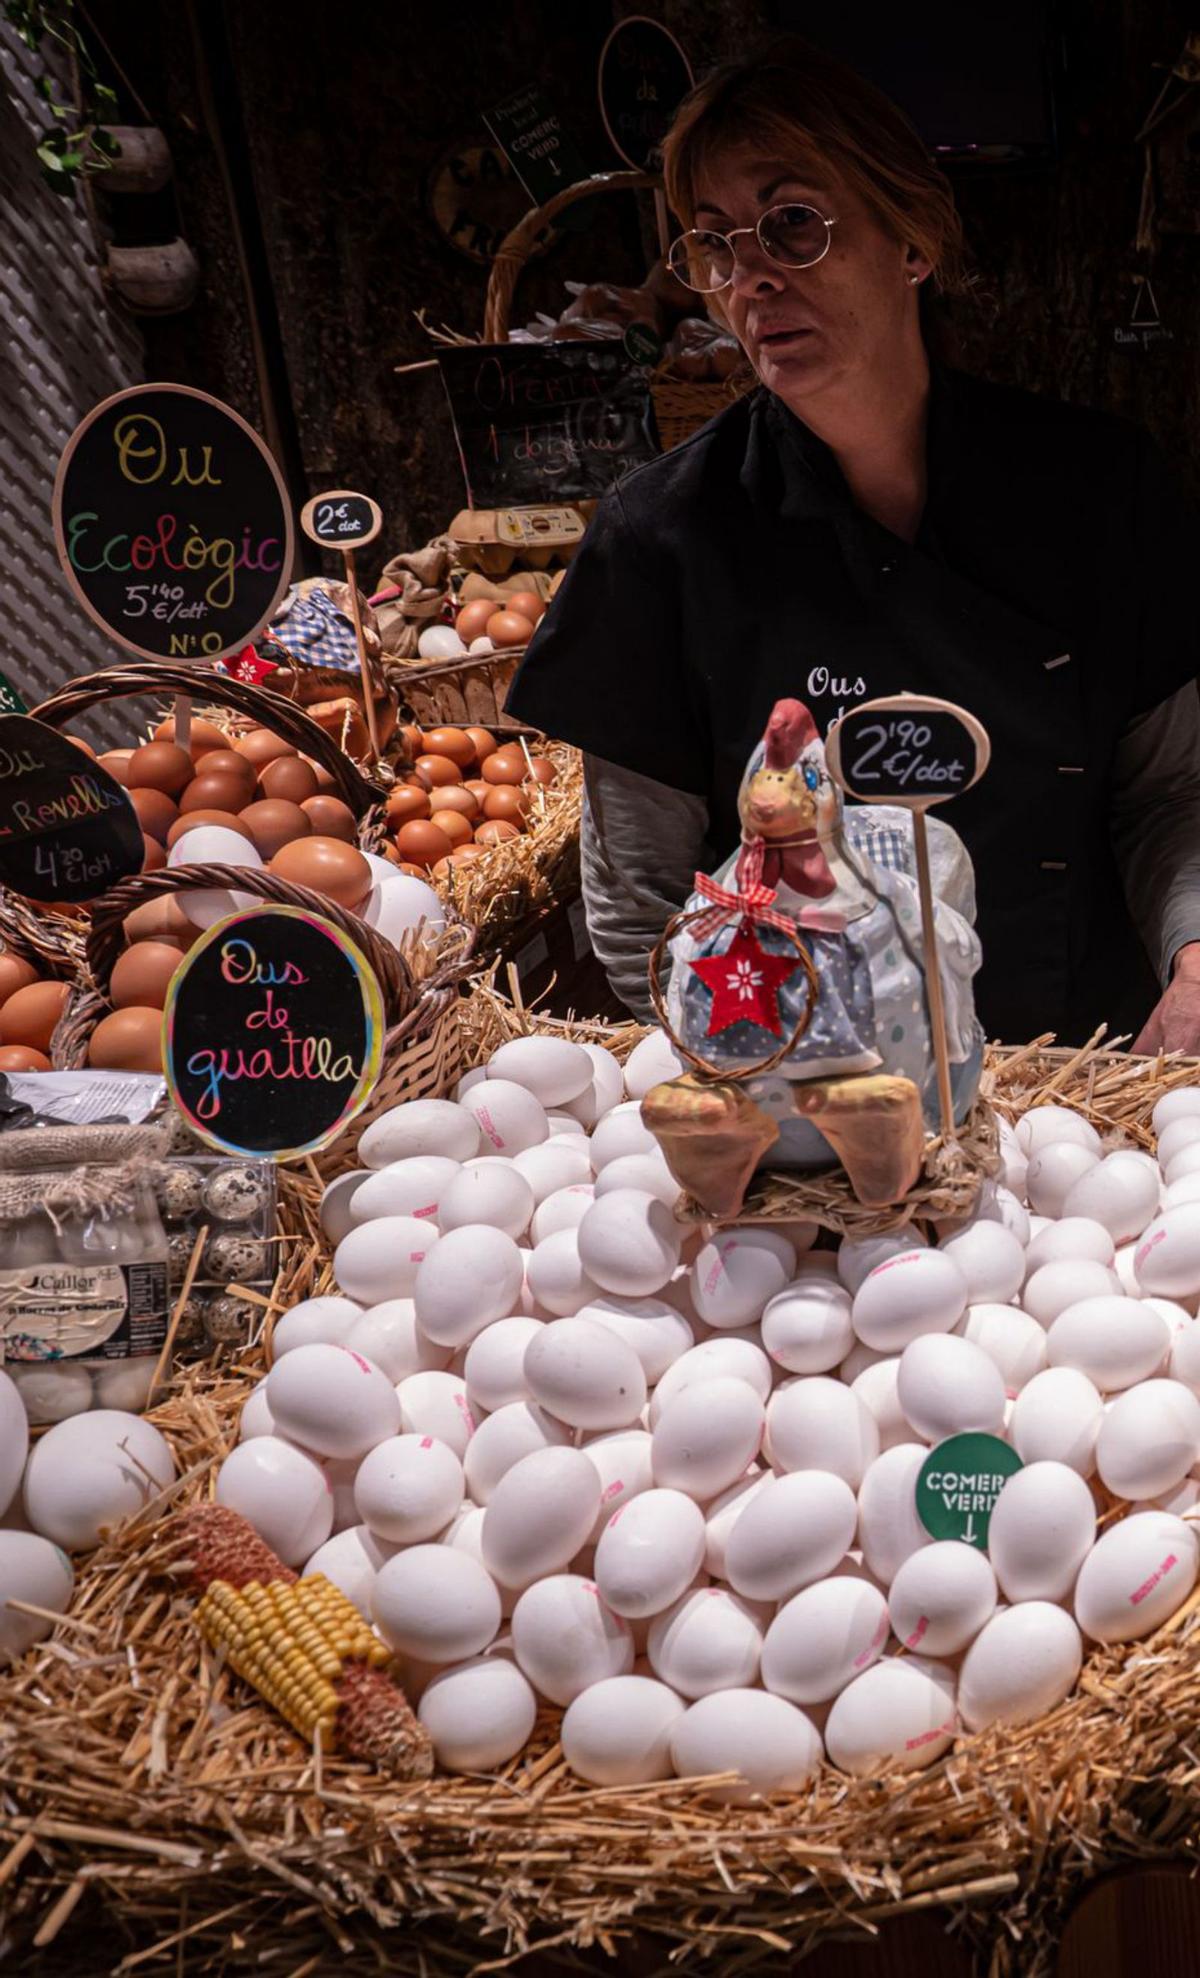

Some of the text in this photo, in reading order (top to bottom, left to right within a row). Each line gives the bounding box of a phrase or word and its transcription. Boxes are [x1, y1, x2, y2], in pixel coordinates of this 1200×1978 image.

[114, 414, 221, 485] Ou
[338, 519, 361, 531] dot
[68, 512, 279, 608] Ecològic
[807, 667, 866, 697] Ous
[12, 774, 121, 831] Rovells
[221, 939, 310, 984] Ous
[246, 990, 290, 1029] de
[187, 1031, 361, 1119] guatlla
[926, 1472, 1005, 1492] COMER
